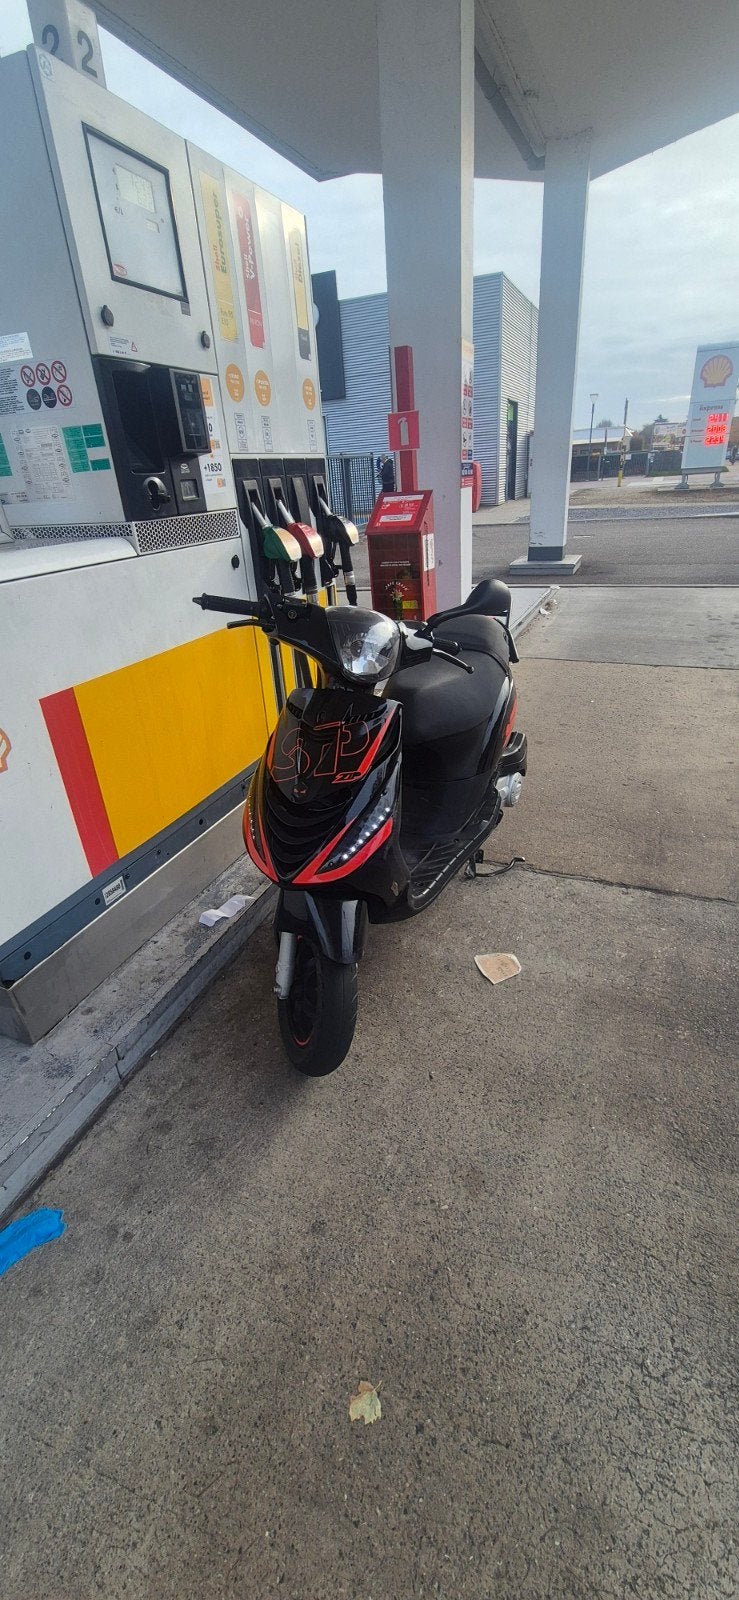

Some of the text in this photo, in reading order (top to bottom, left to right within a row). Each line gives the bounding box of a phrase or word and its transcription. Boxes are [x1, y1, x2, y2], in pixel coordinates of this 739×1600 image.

[42, 24, 60, 56] 2
[77, 30, 97, 78] 2
[212, 191, 227, 273] Eurosuper
